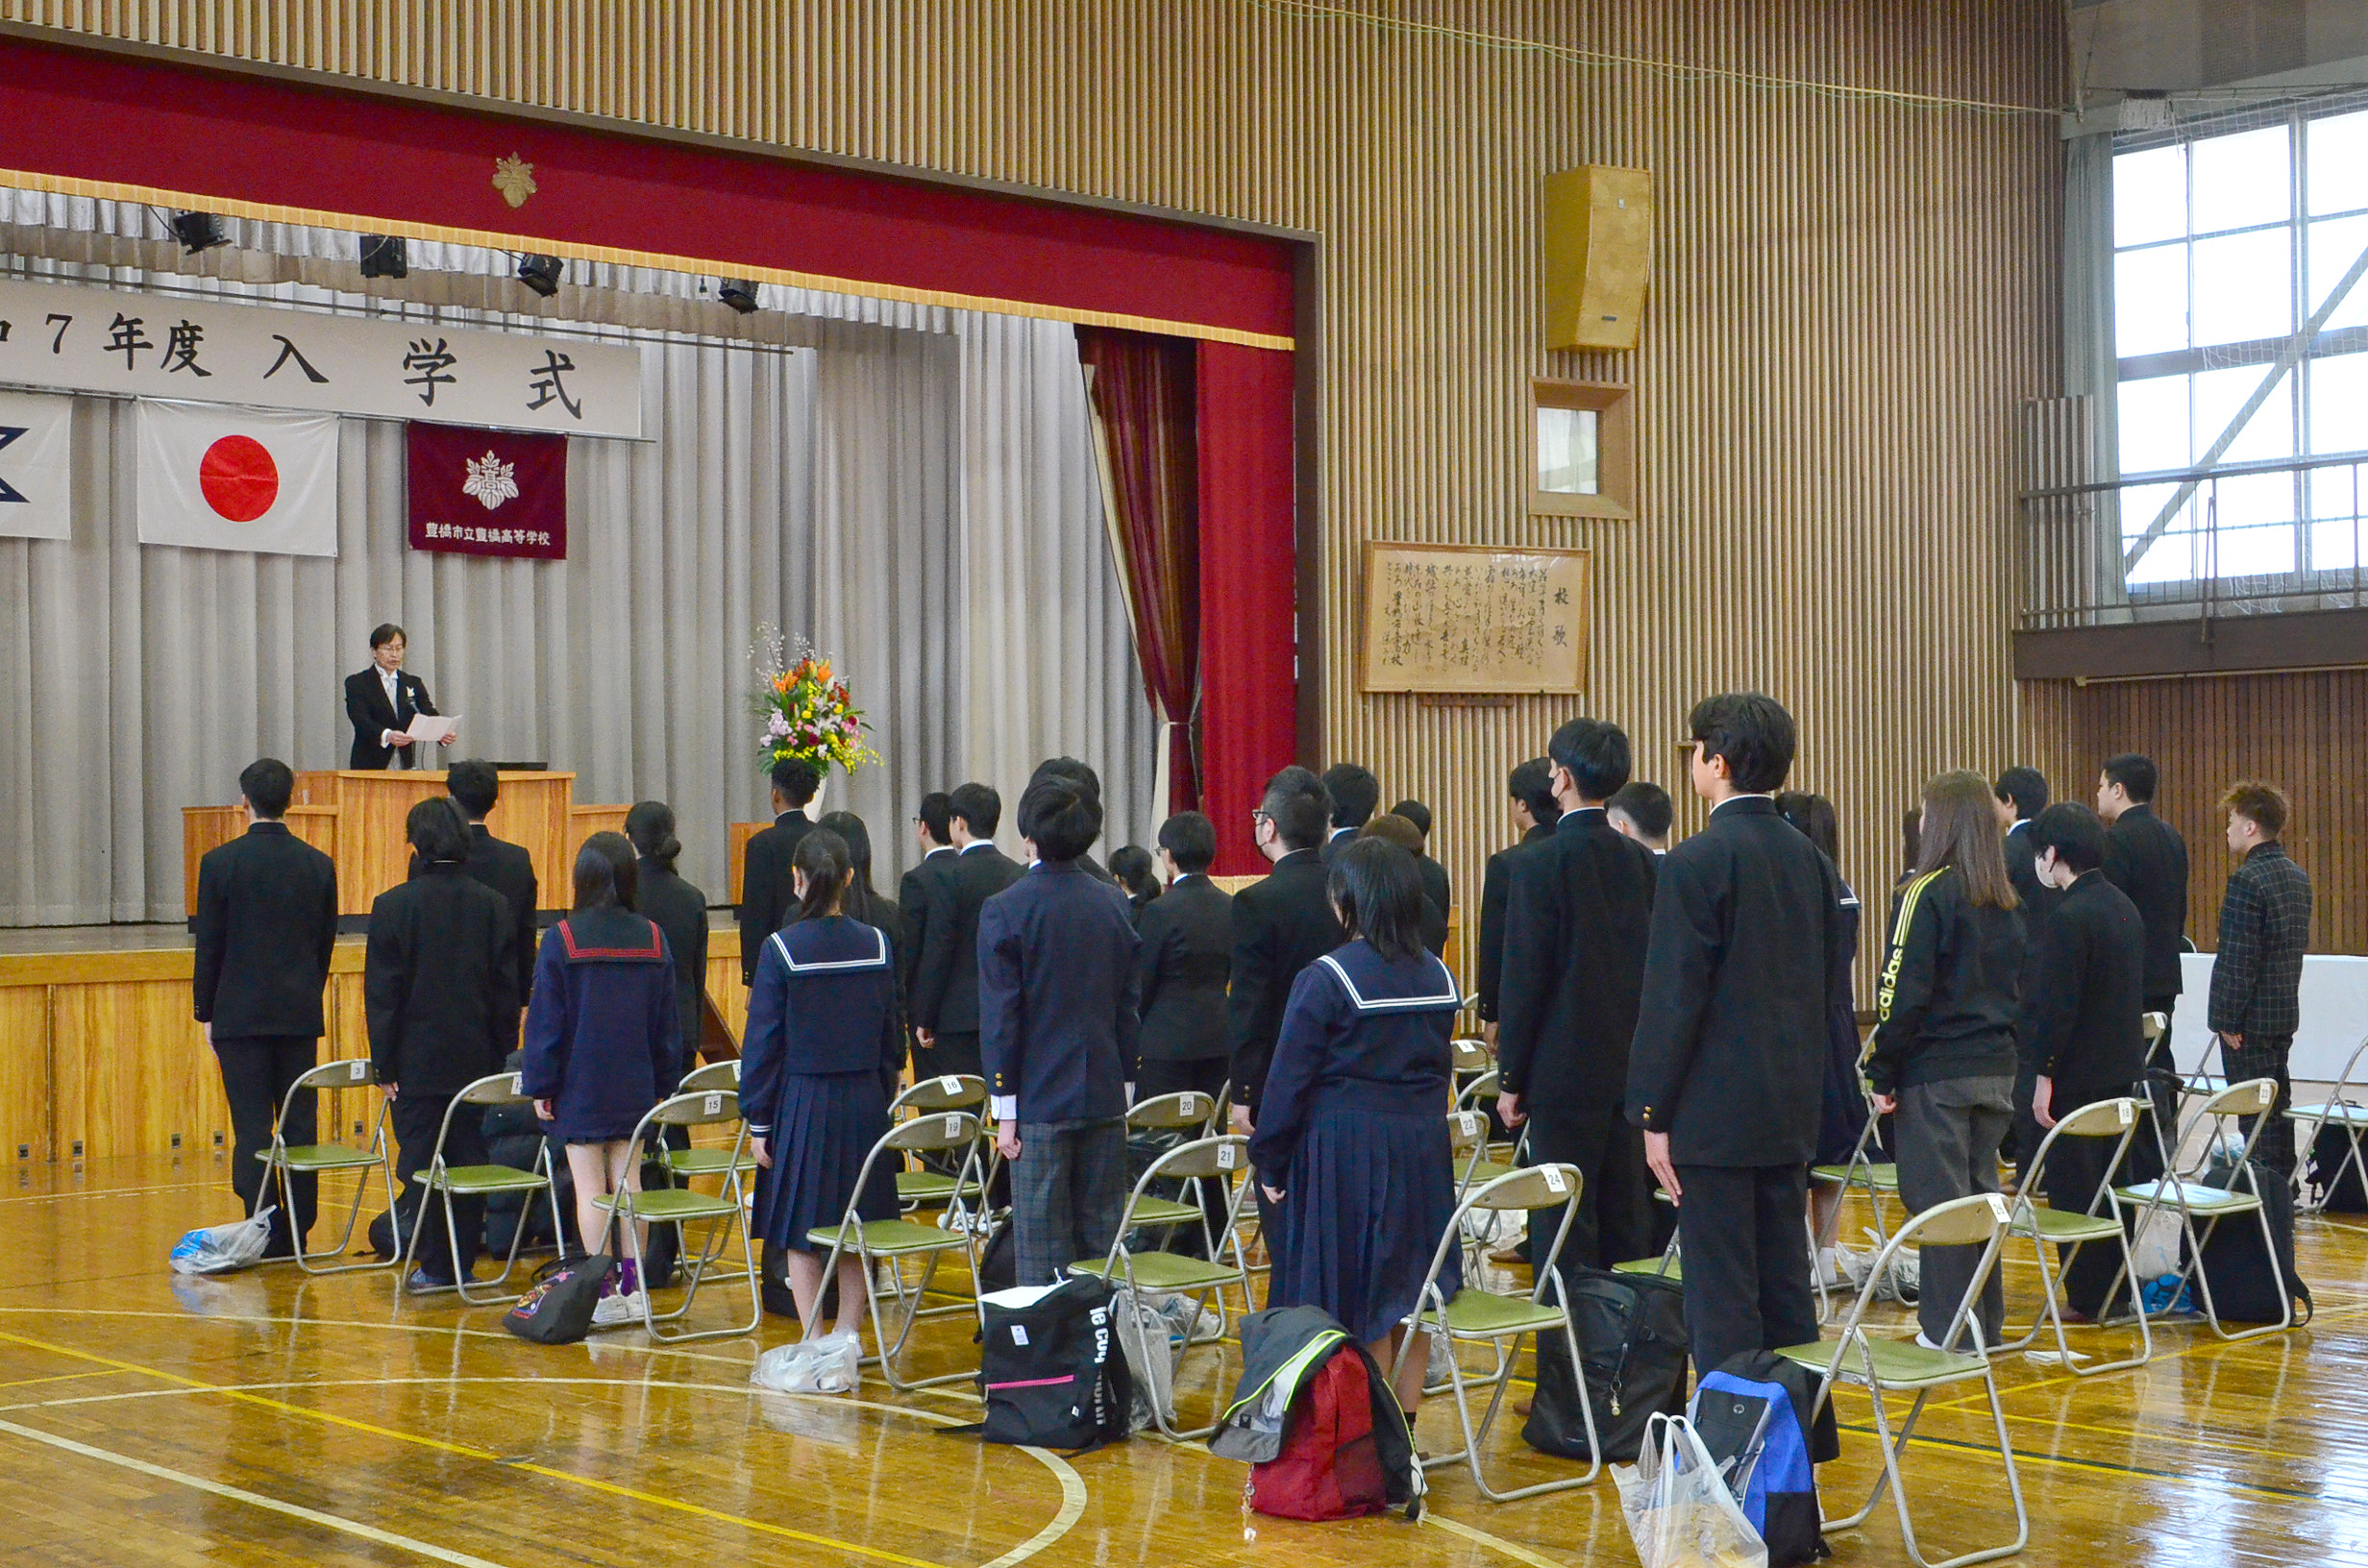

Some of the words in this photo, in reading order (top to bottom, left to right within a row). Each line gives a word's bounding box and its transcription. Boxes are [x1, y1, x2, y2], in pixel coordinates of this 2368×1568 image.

[1879, 947, 1904, 1022] adidas
[355, 1066, 361, 1075] 3
[708, 1100, 719, 1110] 15
[1182, 1101, 1193, 1111] 20
[949, 1122, 958, 1132] 19
[1463, 1119, 1474, 1130] 22
[1221, 1150, 1231, 1162] 21
[1548, 1174, 1562, 1186] 24
